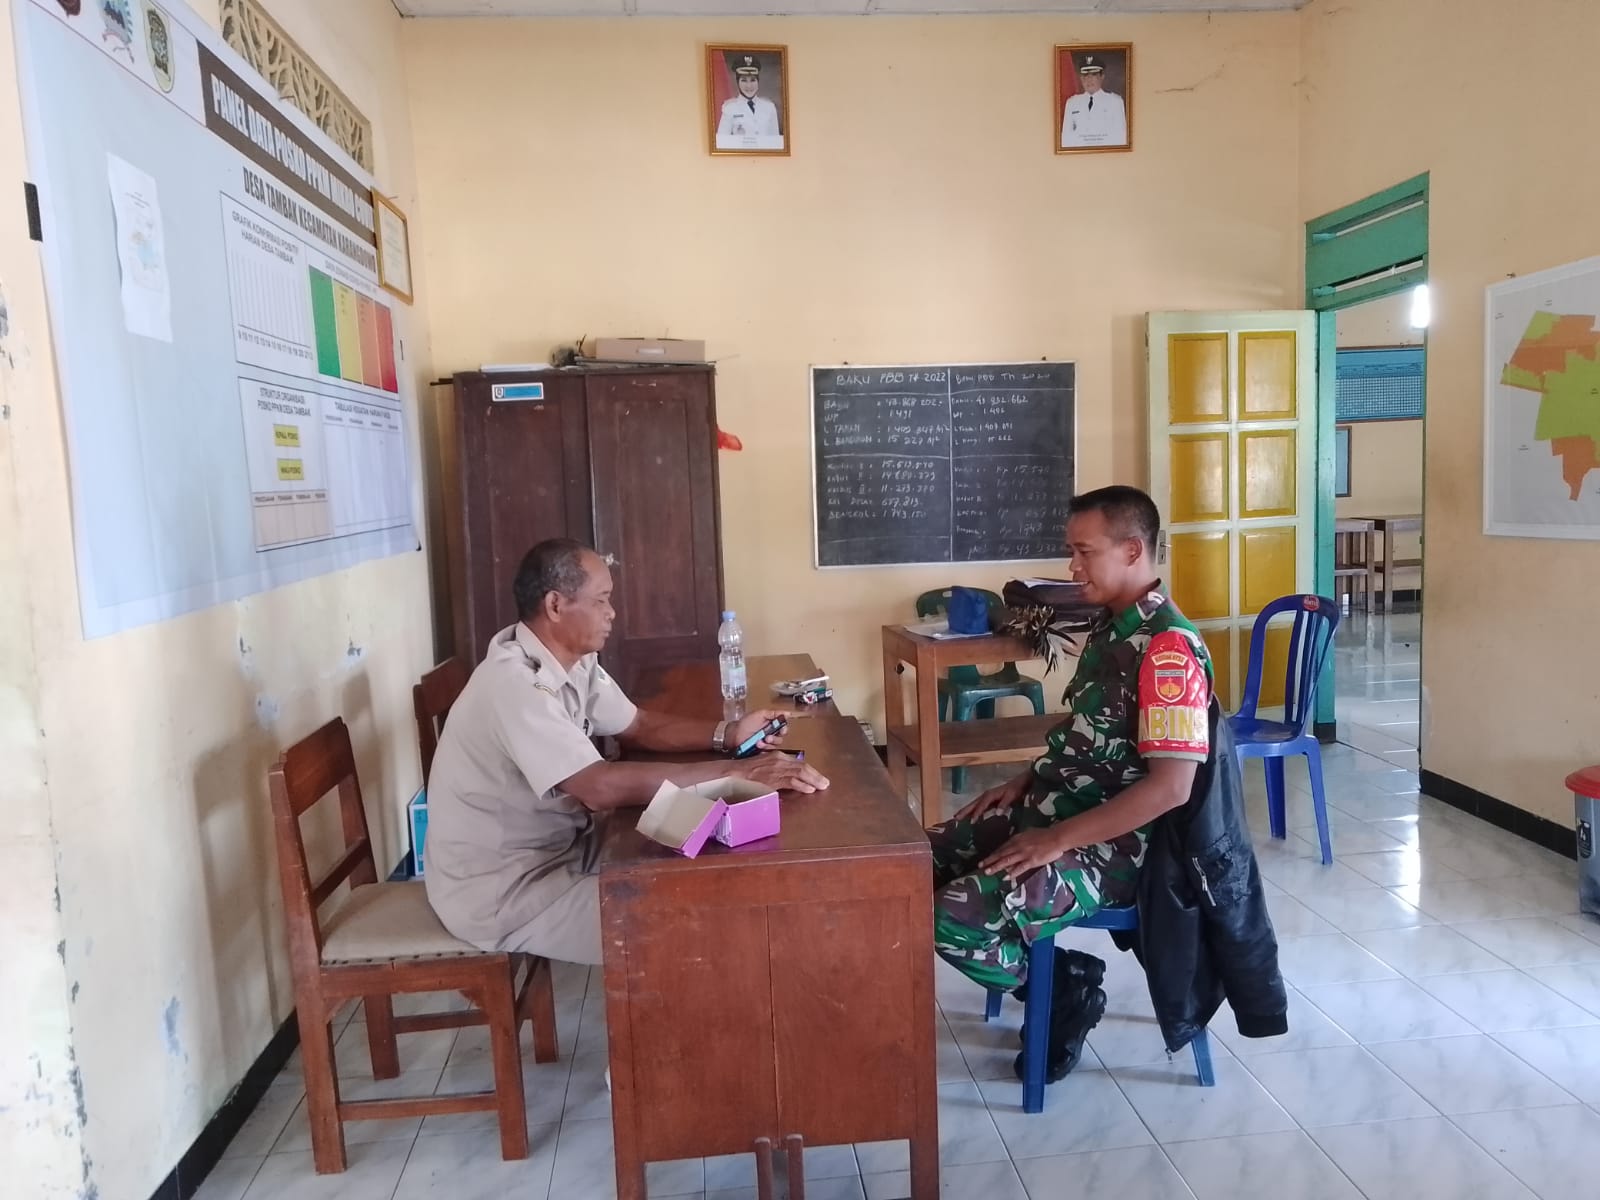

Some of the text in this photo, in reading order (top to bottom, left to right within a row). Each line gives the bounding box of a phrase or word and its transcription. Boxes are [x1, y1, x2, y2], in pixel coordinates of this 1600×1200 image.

[211, 72, 249, 139] PANEL
[247, 104, 276, 159] DATA
[274, 126, 306, 181] POSKO
[305, 152, 331, 200] PPKM
[243, 166, 266, 205] DESA
[266, 182, 298, 226] TAMBAK
[298, 204, 338, 250] KECAMATAN
[836, 374, 870, 386] BAKU
[924, 372, 946, 382] 2022
